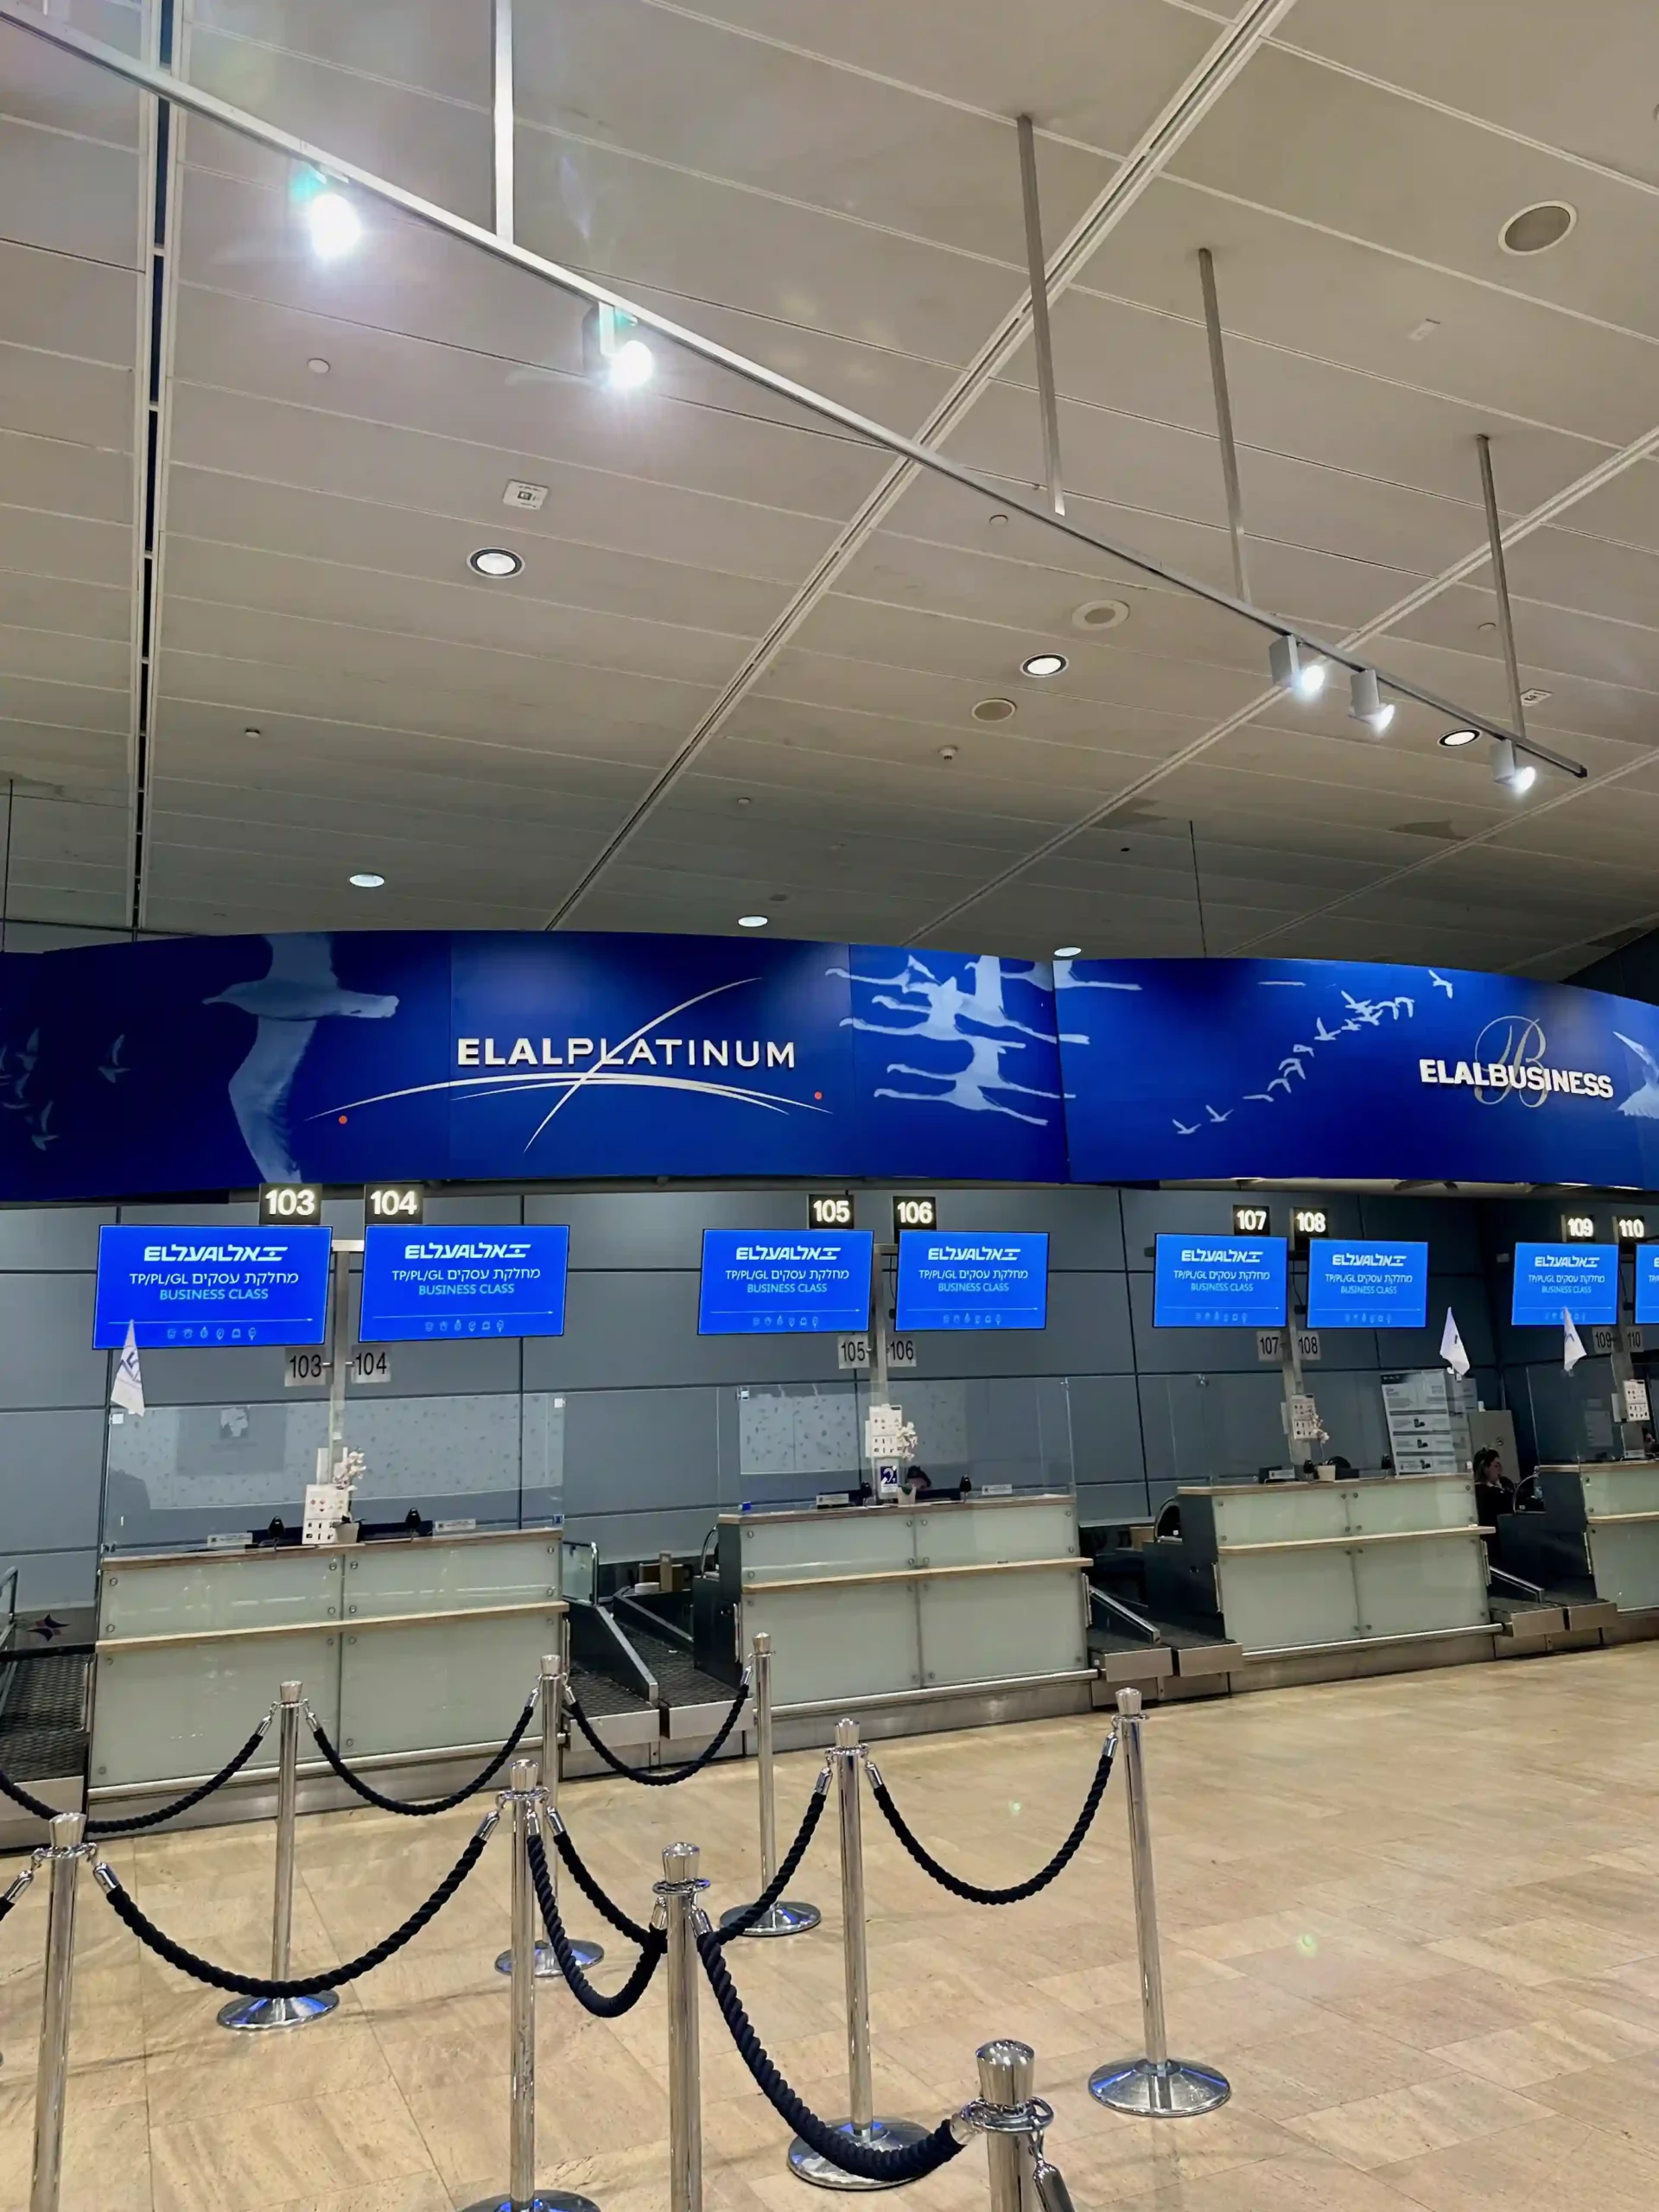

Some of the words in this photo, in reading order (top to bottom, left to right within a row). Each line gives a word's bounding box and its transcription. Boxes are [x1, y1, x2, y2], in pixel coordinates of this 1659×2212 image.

[265, 1189, 315, 1216] 103
[371, 1190, 417, 1216] 104
[813, 1199, 850, 1223] 105
[897, 1201, 932, 1224] 106
[1236, 1210, 1267, 1230] 107
[1296, 1212, 1326, 1233] 108
[1567, 1217, 1593, 1237] 109
[1619, 1218, 1645, 1238] 110
[160, 1288, 225, 1300] BUSINESS
[229, 1288, 268, 1300] CLASS
[419, 1285, 476, 1295] BUSINESS
[480, 1284, 514, 1294] CLASS
[747, 1284, 795, 1294] BUSINESS
[798, 1284, 827, 1293] CLASS
[938, 1283, 981, 1293] BUSINESS
[983, 1283, 1009, 1292] CLASS
[1191, 1283, 1229, 1292] BUSINESS
[1230, 1283, 1253, 1292] CLASS
[1260, 1337, 1278, 1354] 107
[1299, 1337, 1318, 1354] 108
[1595, 1332, 1611, 1348] 109
[1628, 1331, 1641, 1347] 110
[841, 1341, 865, 1362] 105
[890, 1340, 913, 1360] 106
[289, 1354, 321, 1378] 103
[355, 1351, 387, 1376] 104
